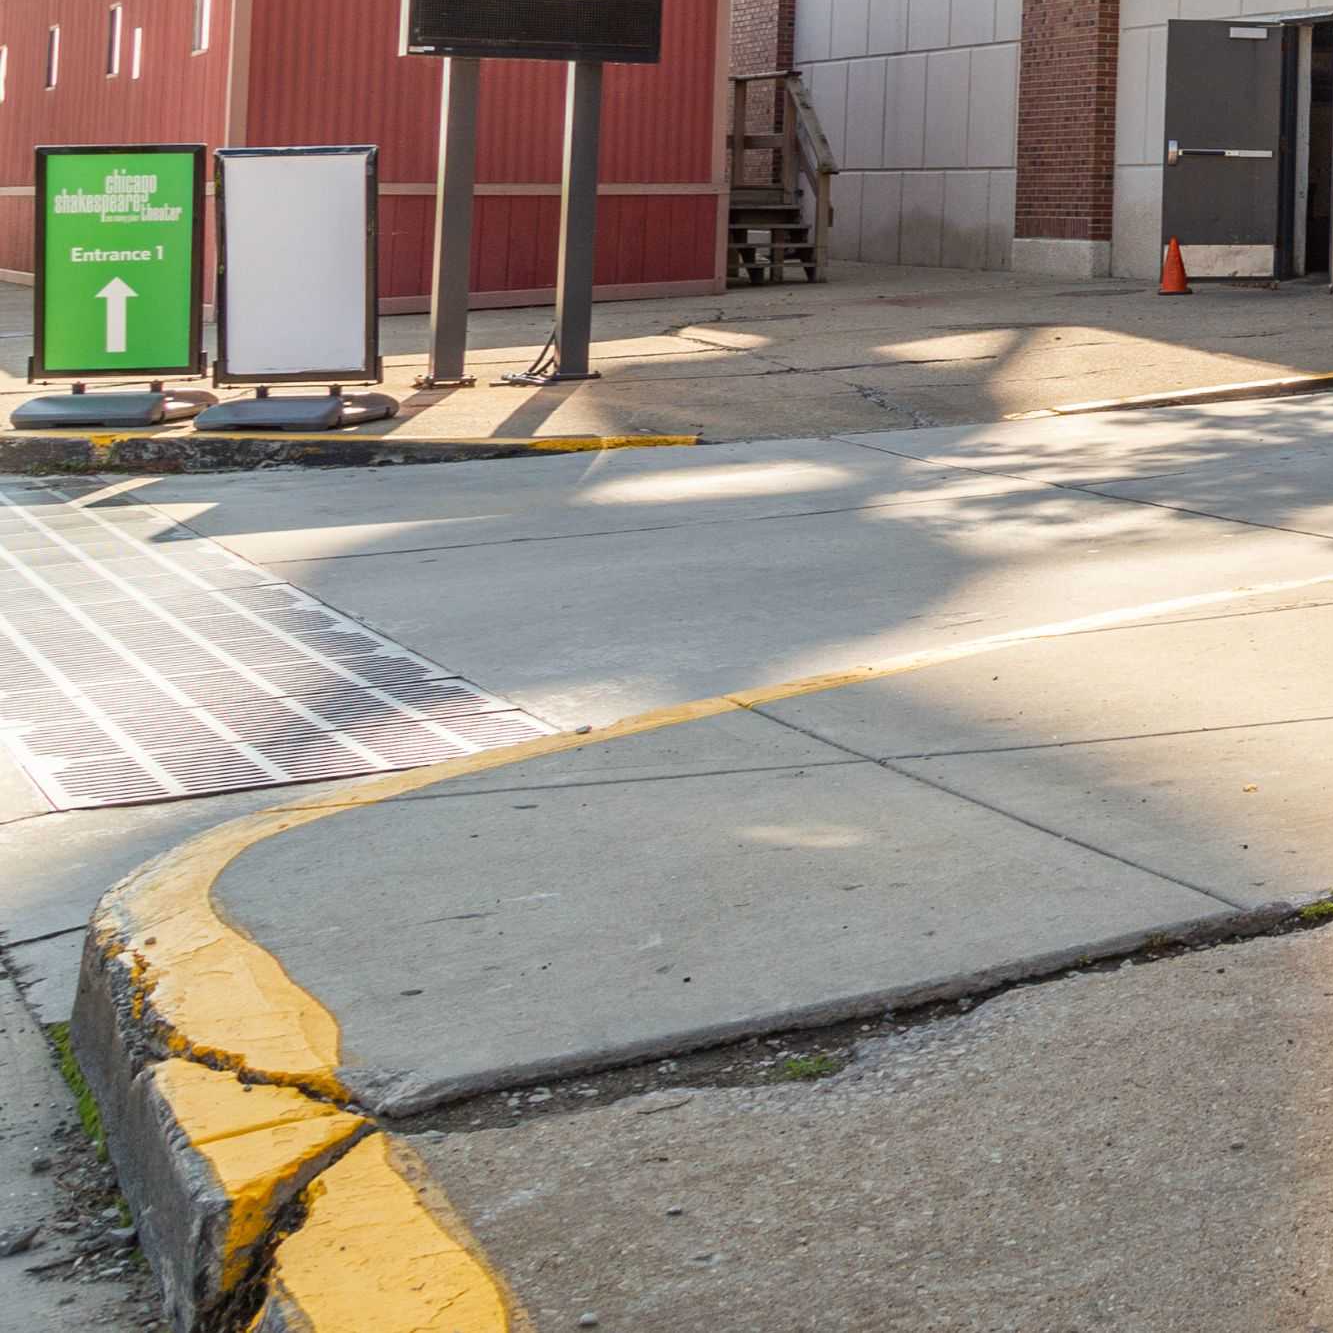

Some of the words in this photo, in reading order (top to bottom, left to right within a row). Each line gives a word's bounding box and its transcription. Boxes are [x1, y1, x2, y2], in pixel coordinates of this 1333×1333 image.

[105, 169, 157, 203] chicago
[54, 188, 141, 222] shakespeare
[141, 203, 182, 222] theater
[70, 247, 152, 262] Entrance
[155, 245, 164, 260] 1
